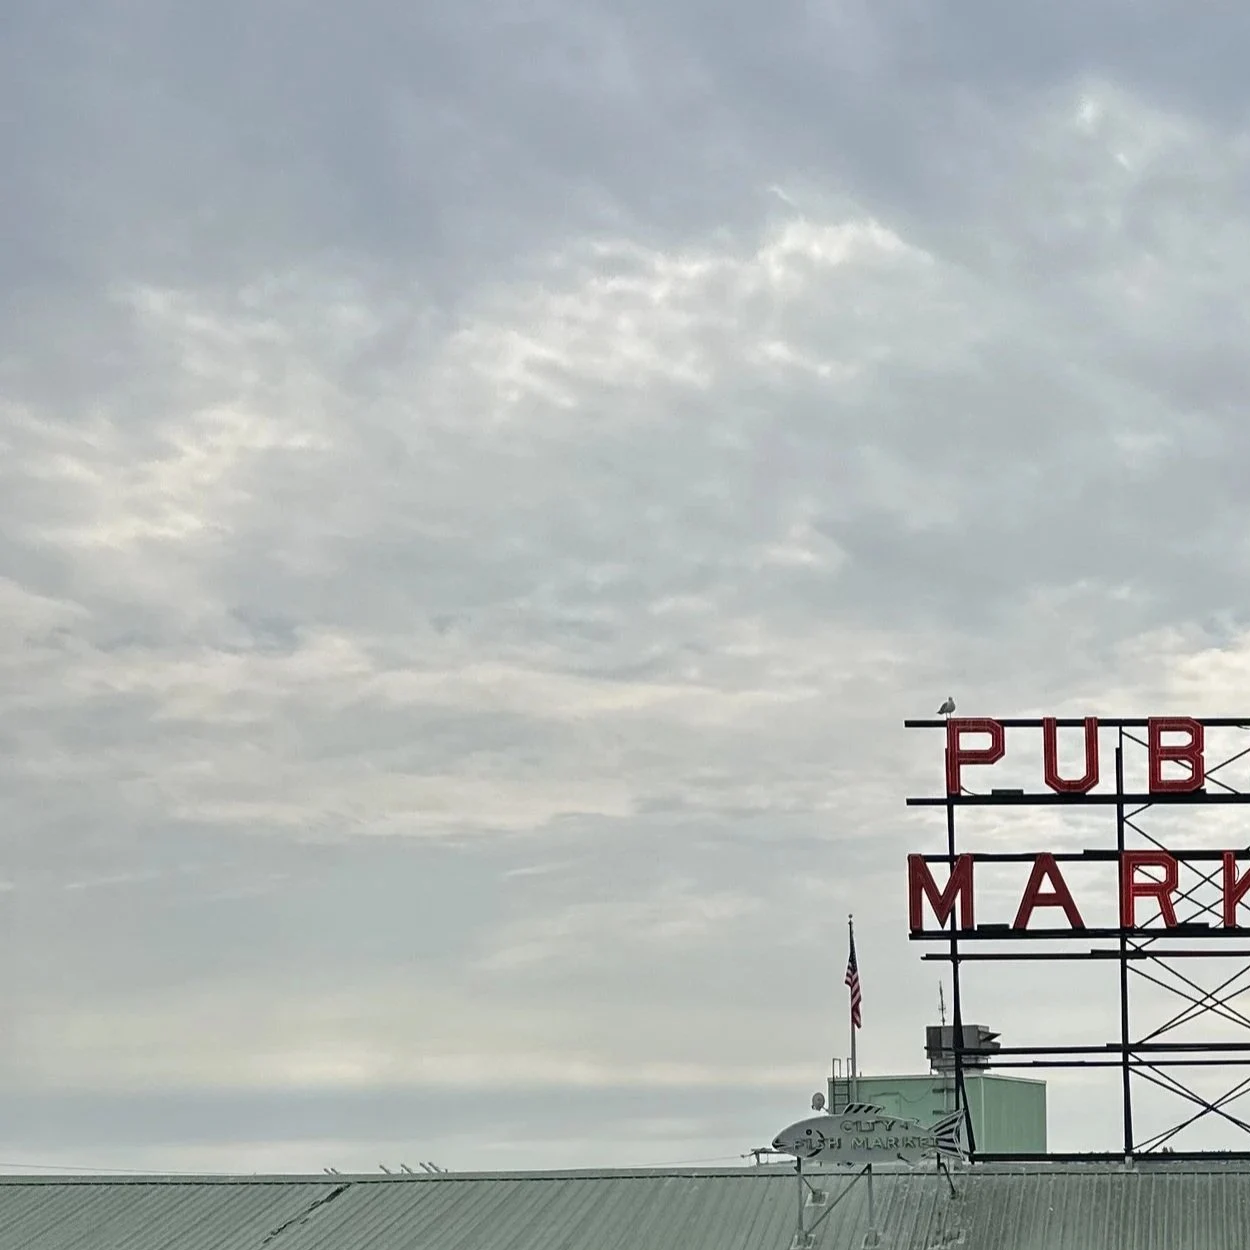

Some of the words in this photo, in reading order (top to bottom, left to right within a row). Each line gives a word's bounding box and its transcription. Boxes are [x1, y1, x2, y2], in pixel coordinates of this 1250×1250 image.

[840, 1120, 896, 1132] CITY
[792, 1137, 841, 1150] FISH
[850, 1136, 940, 1150] MARKET
